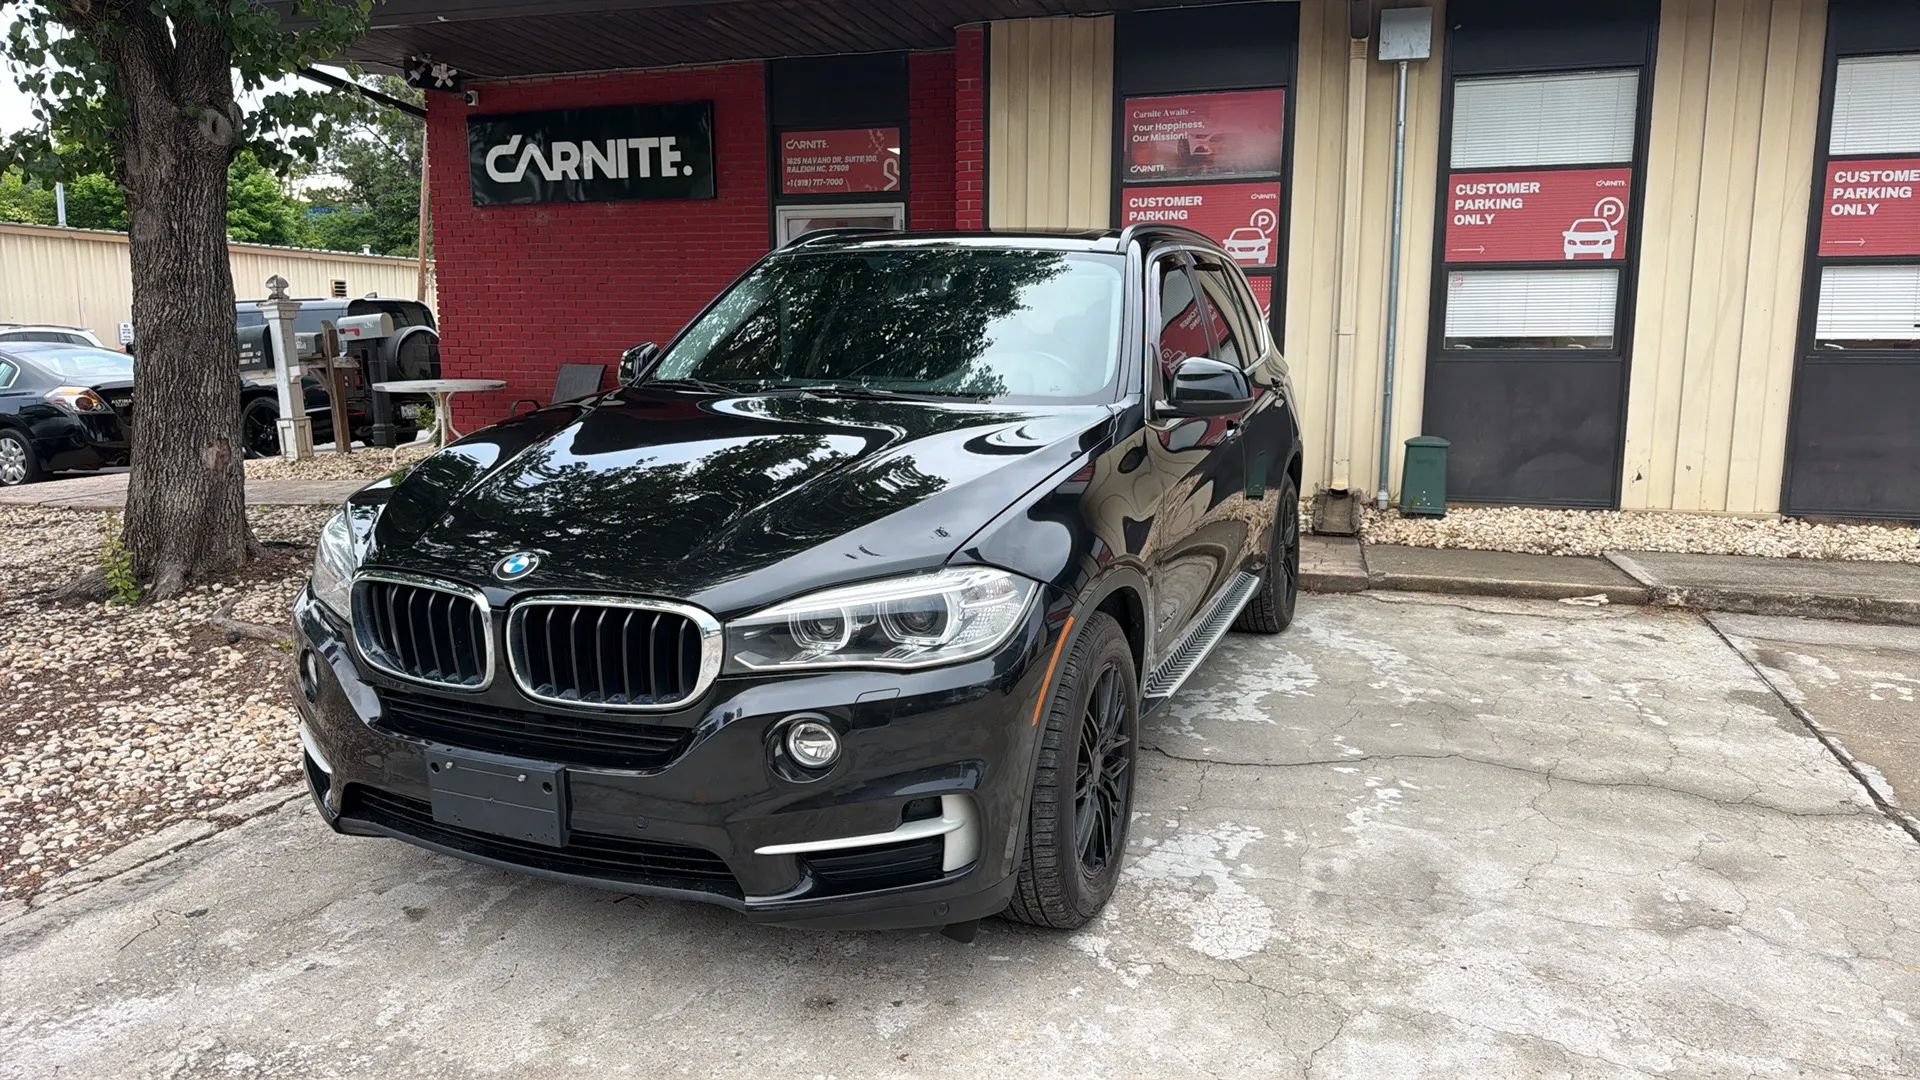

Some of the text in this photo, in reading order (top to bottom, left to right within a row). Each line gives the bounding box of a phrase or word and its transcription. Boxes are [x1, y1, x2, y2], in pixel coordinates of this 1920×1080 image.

[1133, 110, 1162, 119] Carnite
[1163, 108, 1189, 117] Awaits
[1132, 121, 1205, 132] Your Happiness,
[1132, 131, 1188, 142] Our Mission!
[785, 139, 830, 150] CARNITE.
[485, 134, 693, 183] CARNITE.
[844, 154, 864, 163] SUITE
[786, 165, 816, 173] RALEIGH
[1834, 169, 1920, 184] CUSTOME
[1455, 182, 1541, 195] CUSTOMER
[1832, 186, 1913, 200] PARKING
[1129, 196, 1203, 208] CUSTOMER
[1454, 197, 1523, 210] PARKING
[1128, 209, 1189, 221] PARKING
[1830, 203, 1880, 216] ONLY
[1453, 213, 1496, 226] ONLY
